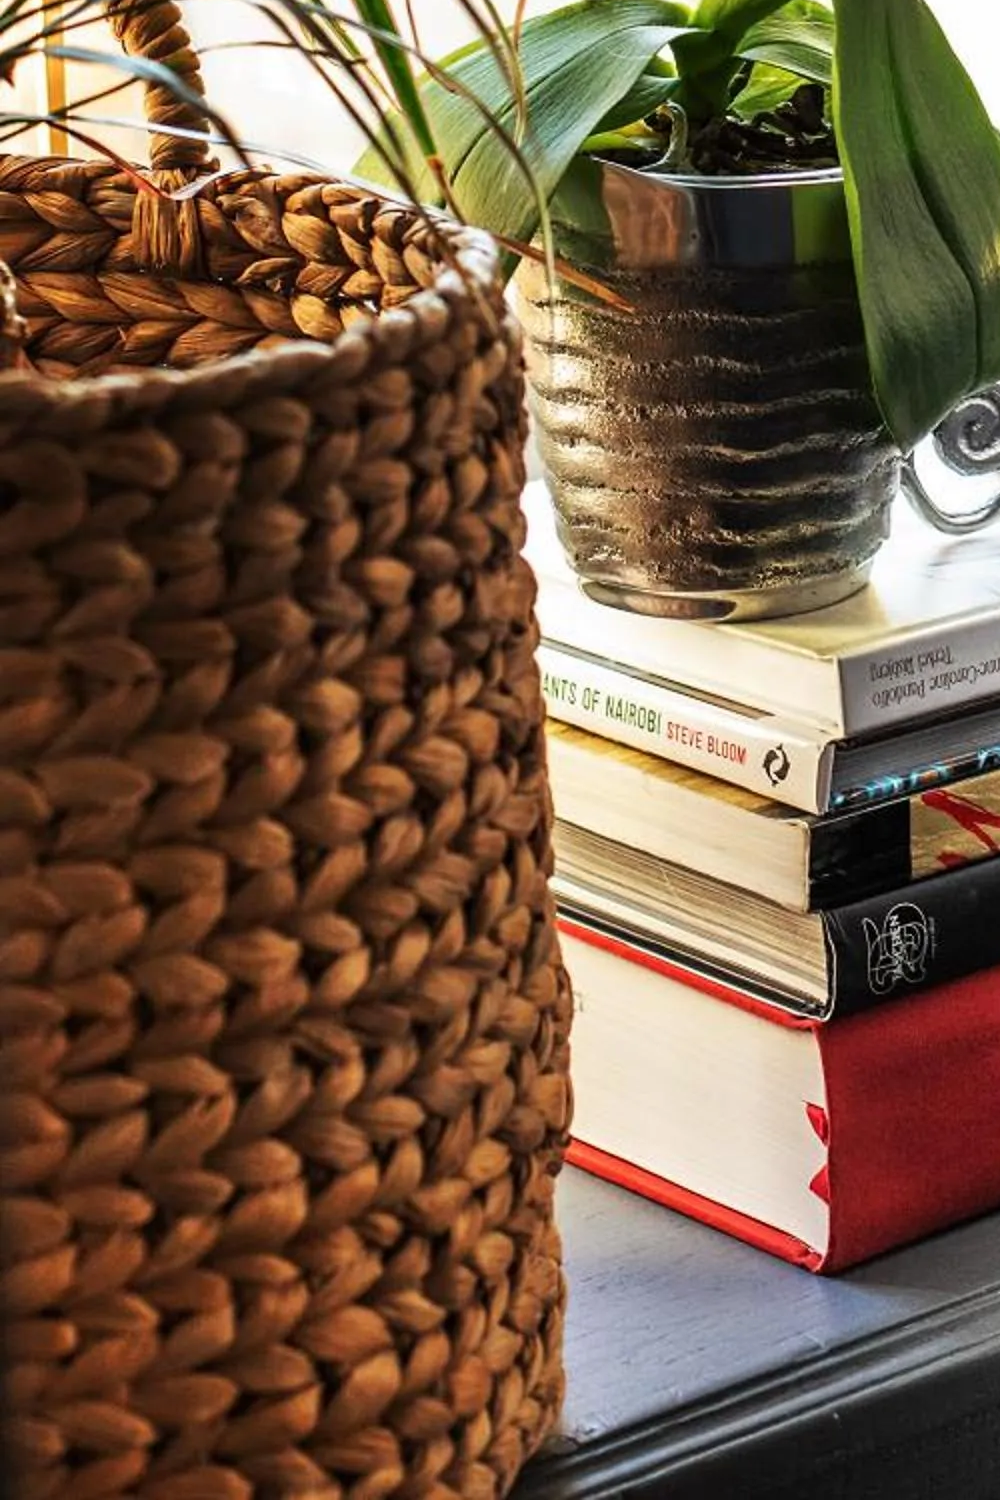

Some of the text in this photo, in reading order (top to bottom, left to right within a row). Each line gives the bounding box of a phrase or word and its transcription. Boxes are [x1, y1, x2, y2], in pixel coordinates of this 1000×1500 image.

[581, 687, 601, 713] OF
[605, 693, 662, 736] NAIROBI
[666, 720, 704, 750] STEVE
[707, 731, 748, 766] BLOOM
